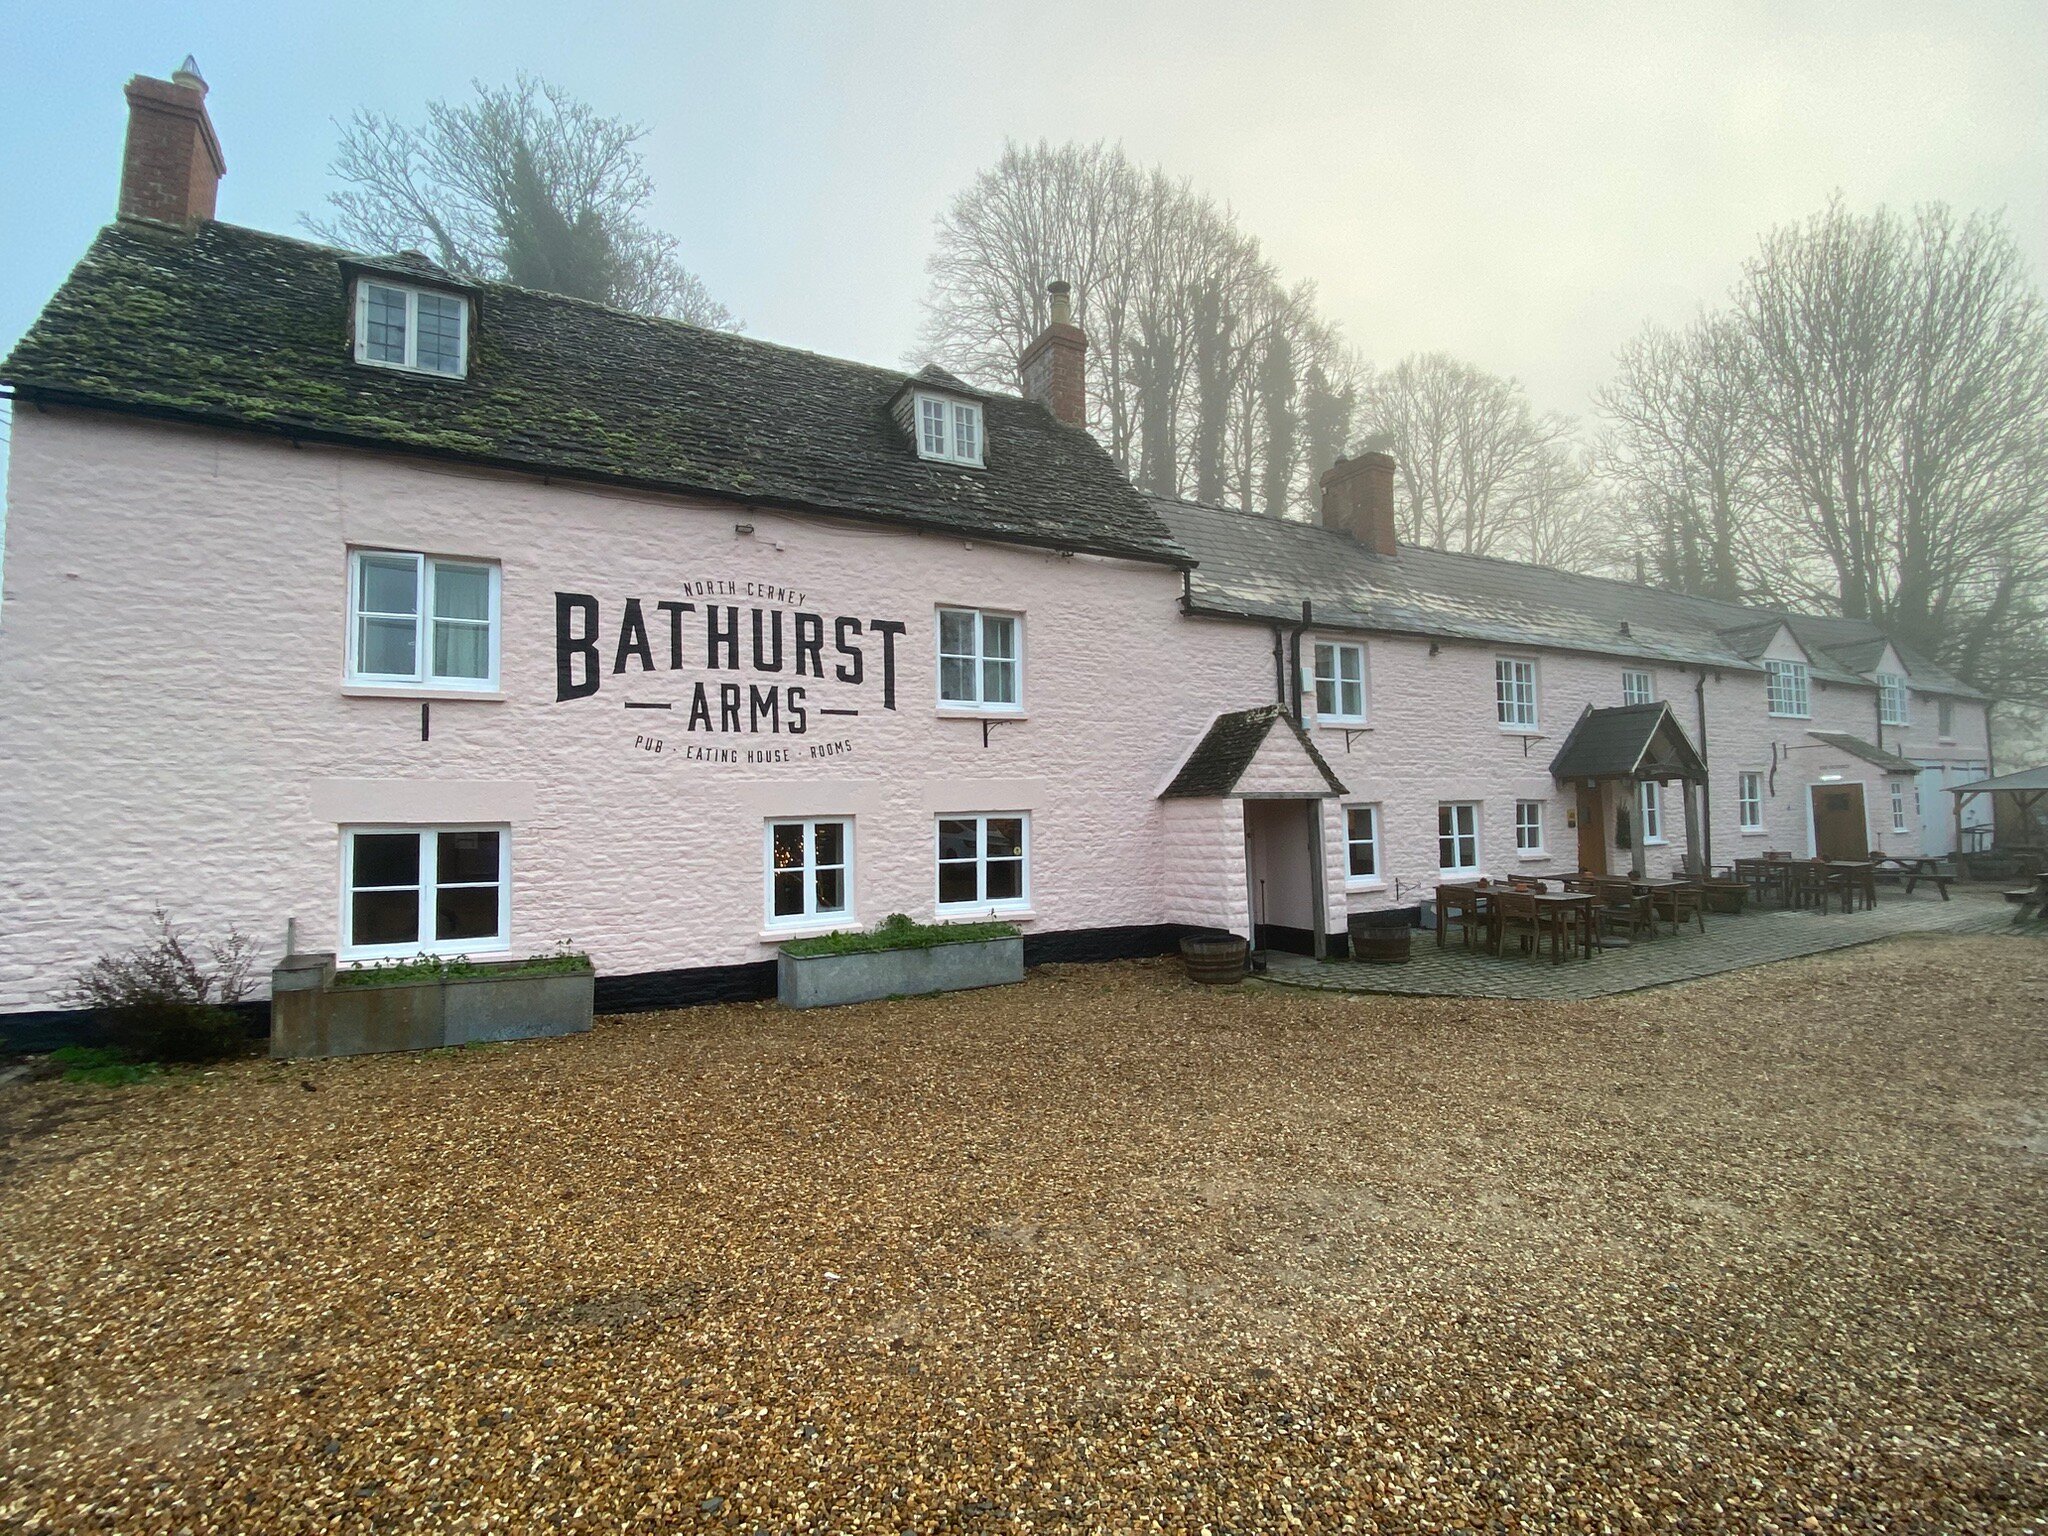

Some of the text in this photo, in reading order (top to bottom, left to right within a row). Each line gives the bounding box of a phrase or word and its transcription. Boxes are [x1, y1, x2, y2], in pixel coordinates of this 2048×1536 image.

[684, 580, 806, 606] NORTH CERNEY
[554, 591, 906, 711] BATHURST
[688, 682, 808, 734] ARMS
[635, 735, 852, 763] PUB EATING HOUSE ROOMS
